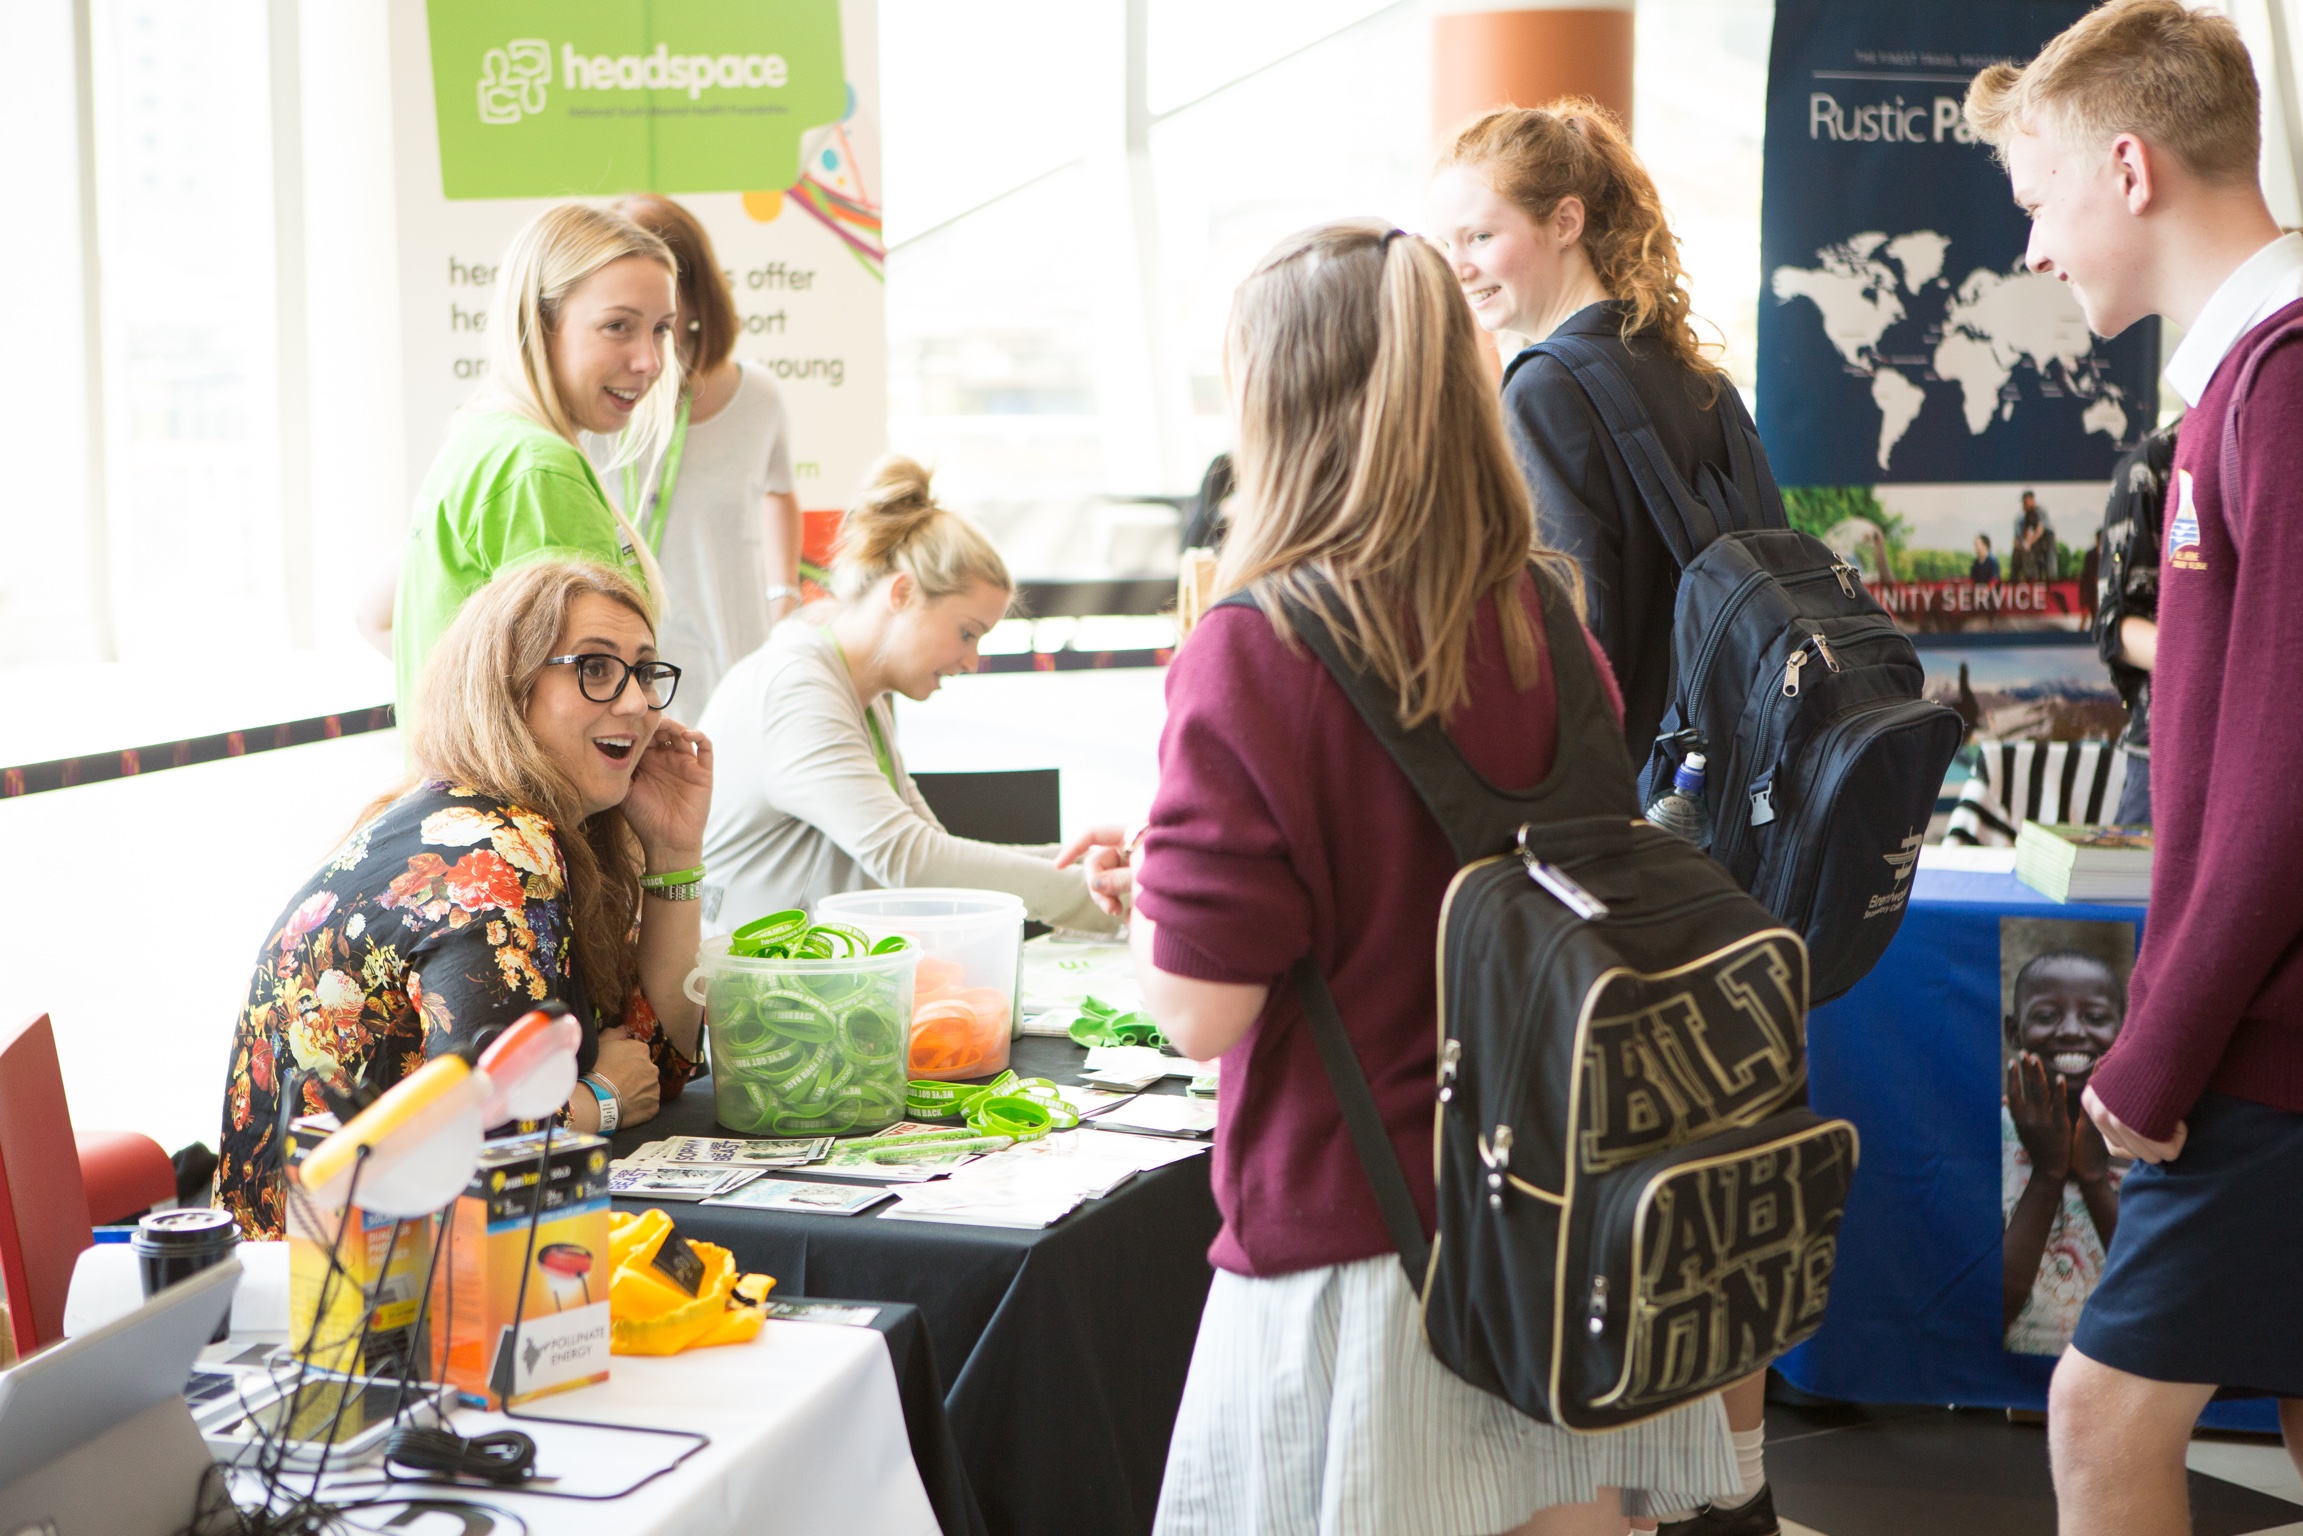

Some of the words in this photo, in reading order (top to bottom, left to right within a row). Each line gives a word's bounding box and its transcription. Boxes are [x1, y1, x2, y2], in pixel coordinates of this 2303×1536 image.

[562, 43, 788, 99] headspace
[1810, 92, 1927, 143] Rustic
[747, 262, 816, 291] offer
[760, 357, 846, 387] oung
[1941, 582, 2048, 612] SERVICE
[922, 1108, 943, 1118] BACK
[552, 1327, 605, 1350] POLLINATE
[551, 1345, 593, 1366] ENERGY
